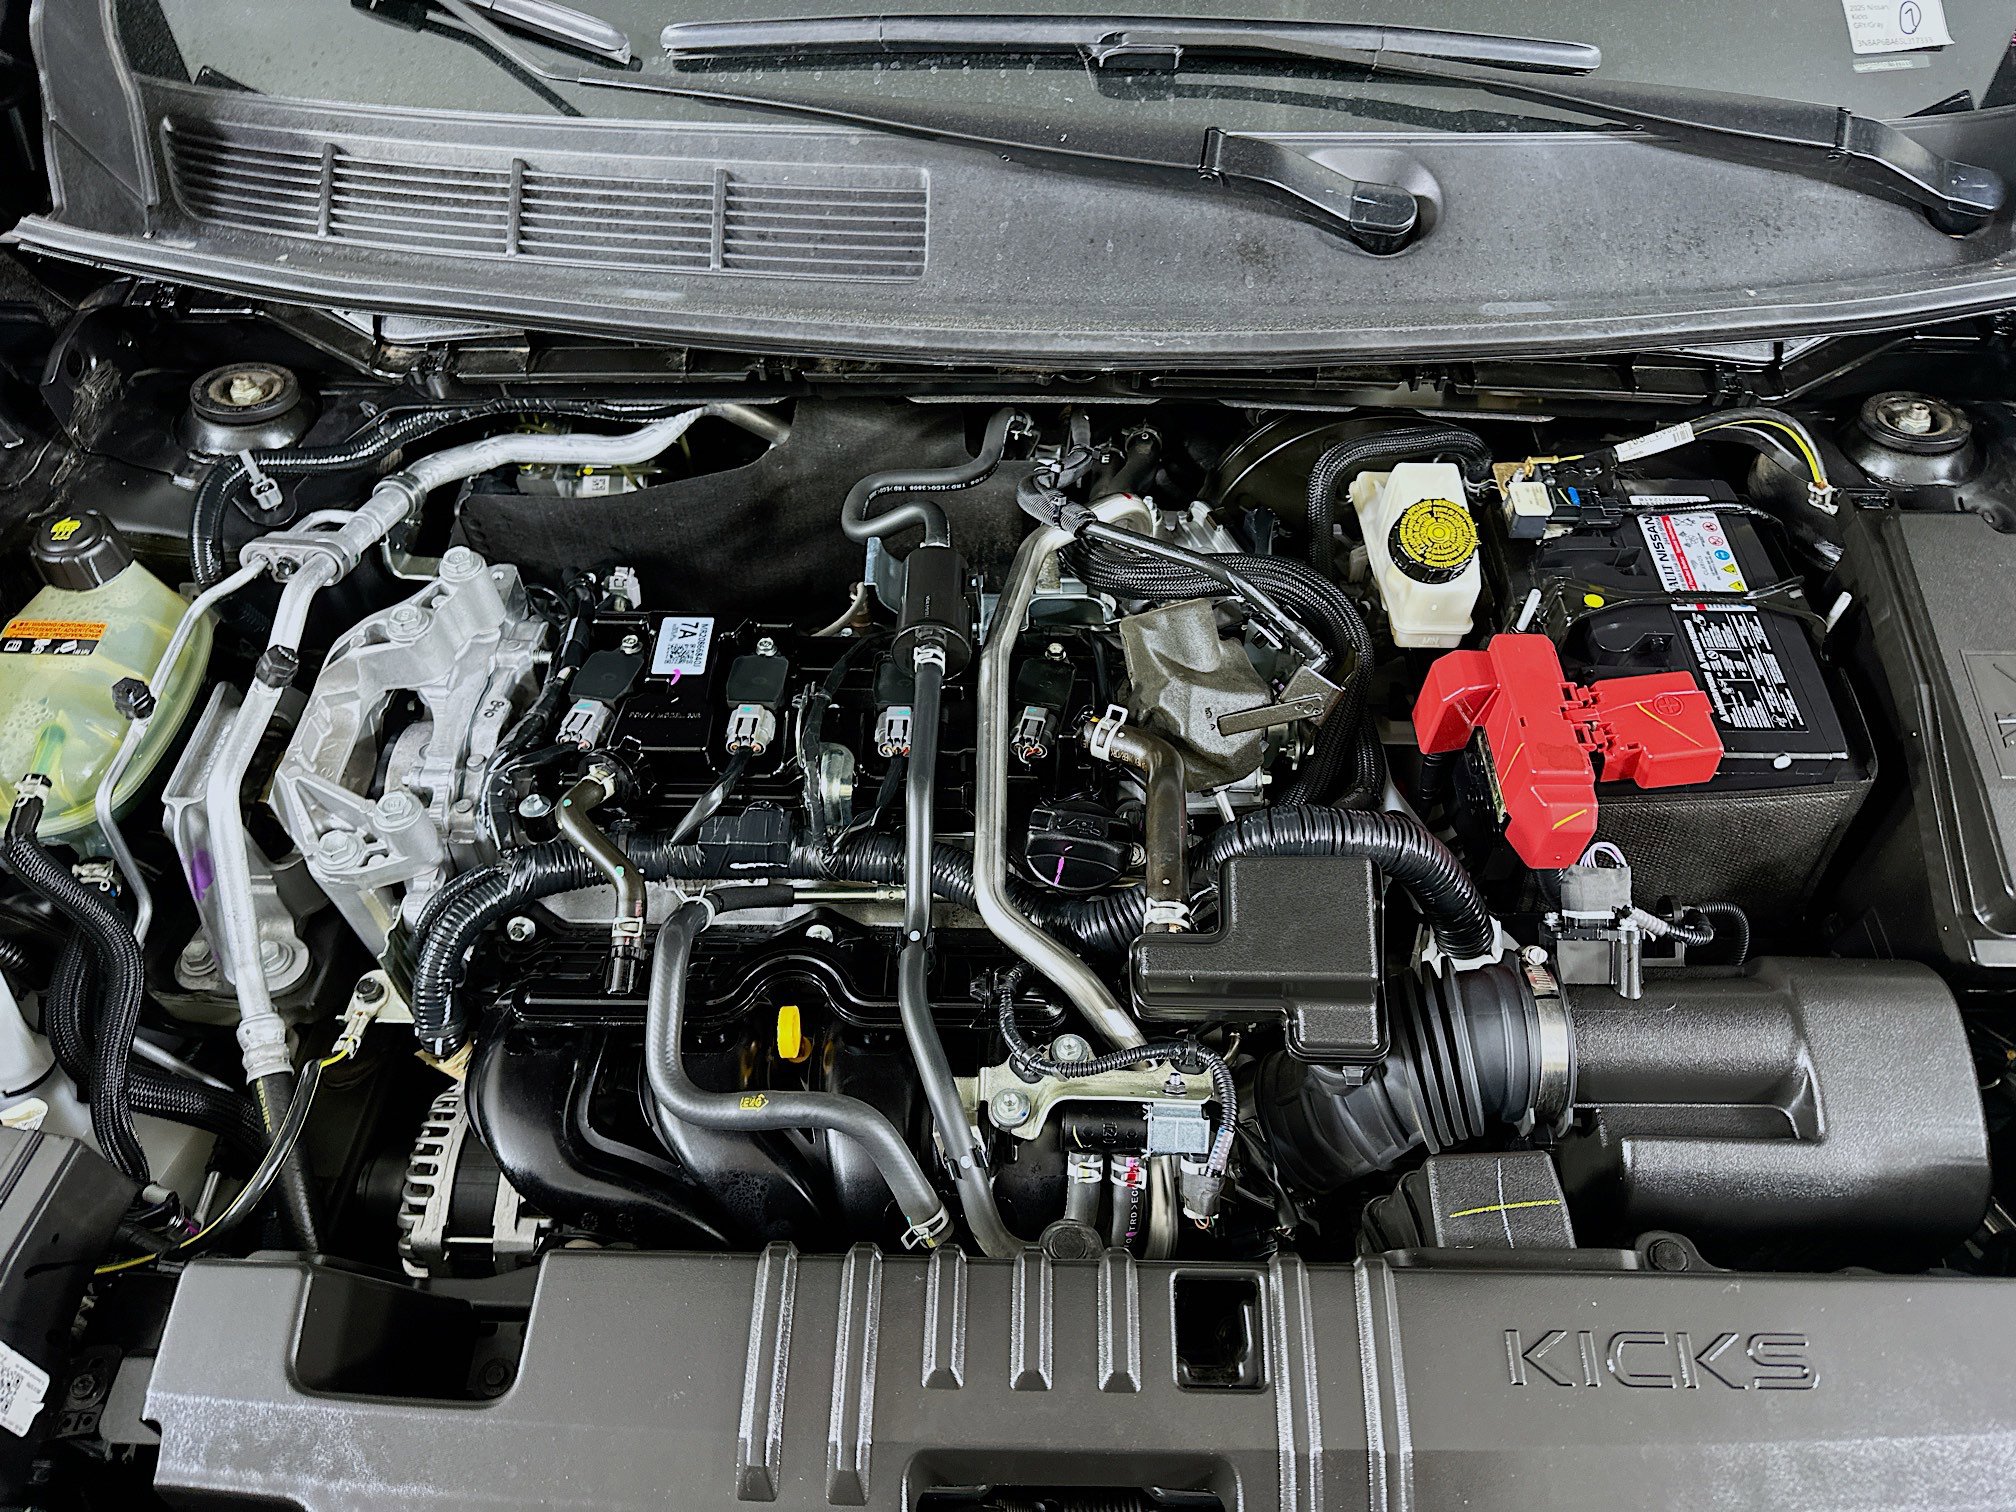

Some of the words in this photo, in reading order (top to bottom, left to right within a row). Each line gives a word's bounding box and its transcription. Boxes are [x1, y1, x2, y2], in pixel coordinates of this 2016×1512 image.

[1101, 454, 1111, 463] E
[1642, 516, 1670, 562] NISSAN
[679, 622, 699, 639] 7A
[1503, 1328, 1821, 1390] KICKS
